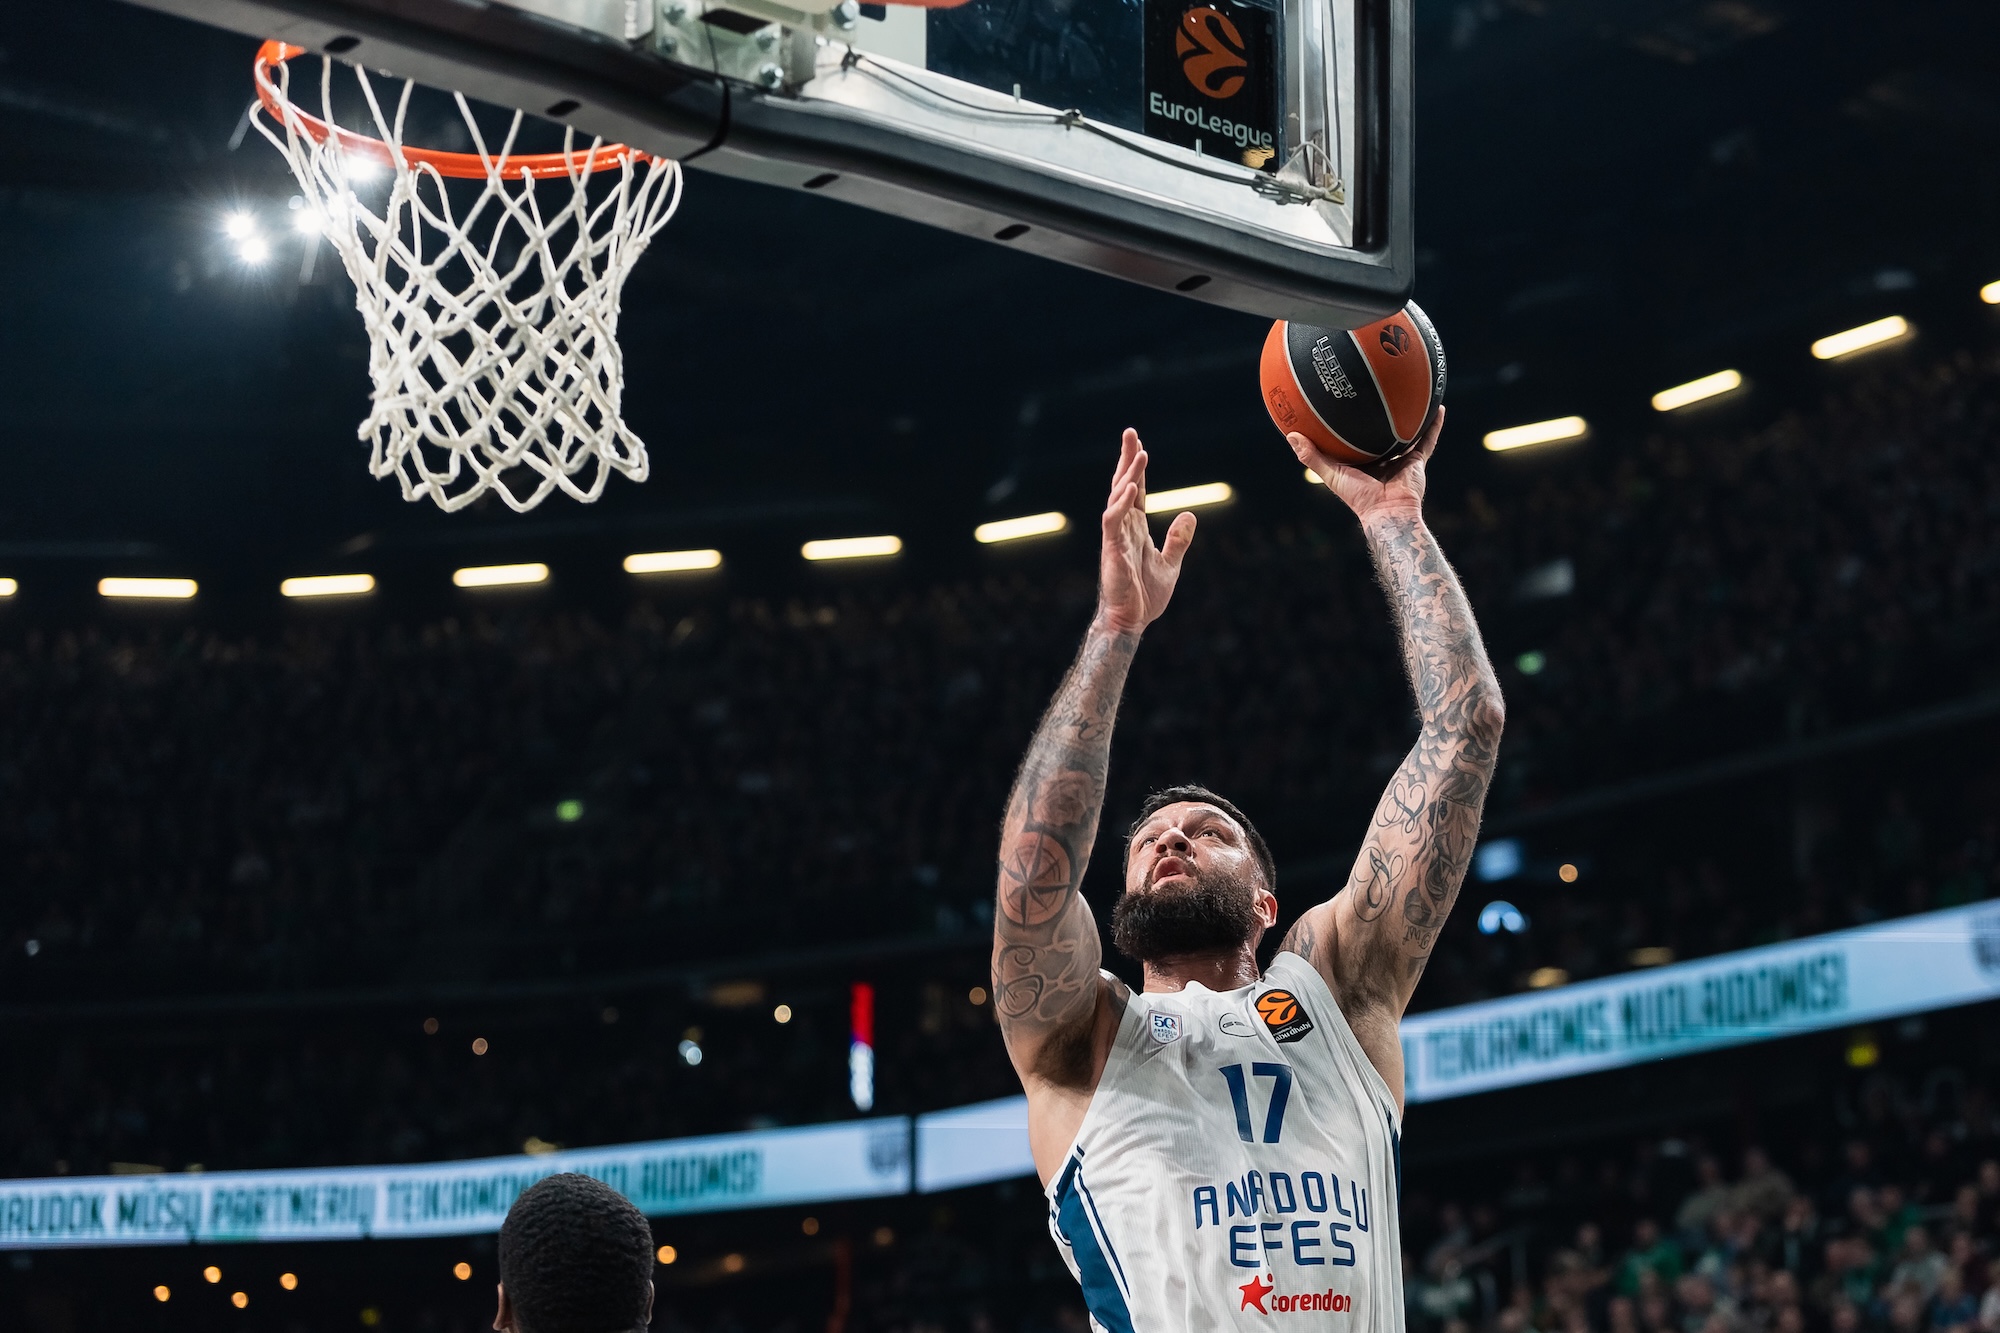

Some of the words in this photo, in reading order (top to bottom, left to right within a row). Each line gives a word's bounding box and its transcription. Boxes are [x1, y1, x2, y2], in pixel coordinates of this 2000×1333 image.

[1150, 92, 1273, 148] EuroLeague
[1316, 335, 1357, 399] LEGACY
[1154, 1015, 1177, 1029] 50
[1218, 1062, 1293, 1144] 17
[1193, 1170, 1369, 1232] ANADOLU
[1229, 1220, 1356, 1268] EFES
[1271, 1289, 1351, 1313] corendon
